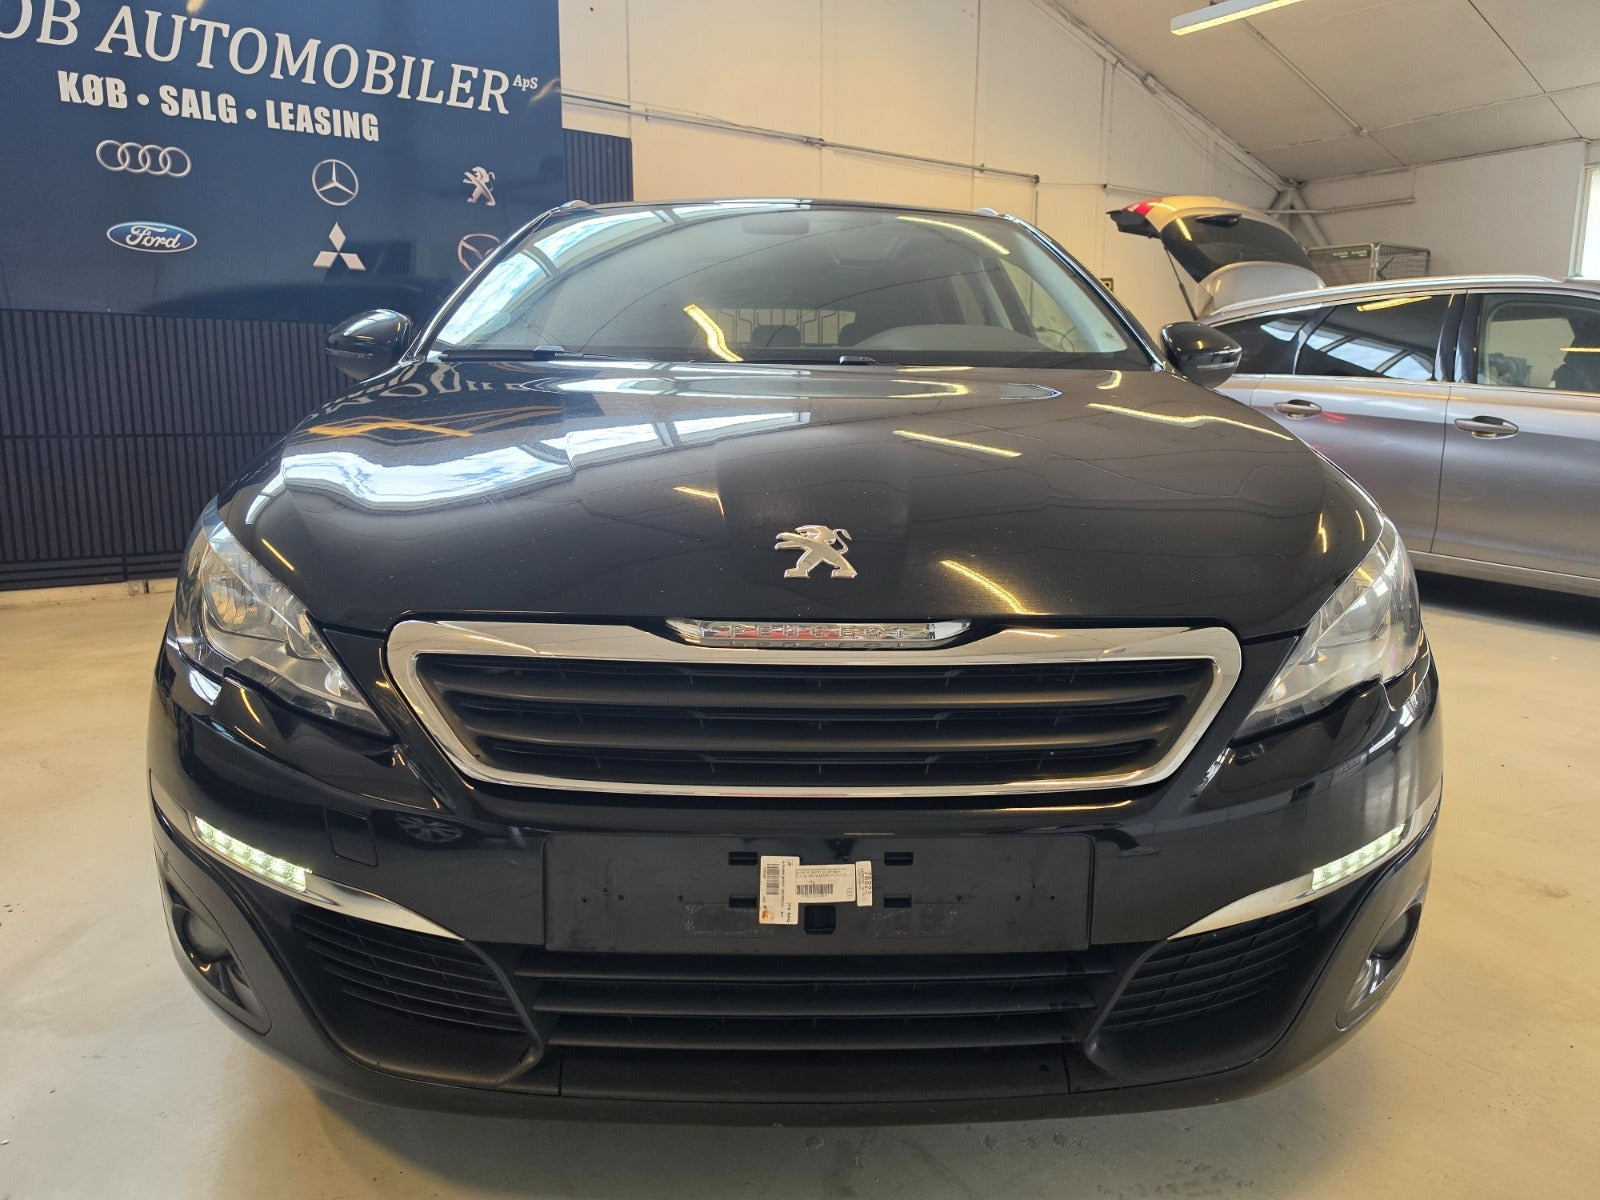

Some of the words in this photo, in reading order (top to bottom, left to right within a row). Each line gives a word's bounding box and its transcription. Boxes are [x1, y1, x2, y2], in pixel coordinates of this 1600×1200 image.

[94, 5, 510, 115] AUTOMOBILER
[512, 73, 539, 92] ApS
[57, 70, 127, 109] KØB
[159, 84, 238, 124] SALG
[266, 99, 380, 142] LEASING
[124, 224, 182, 249] Ford
[729, 624, 907, 638] PEUGEOT
